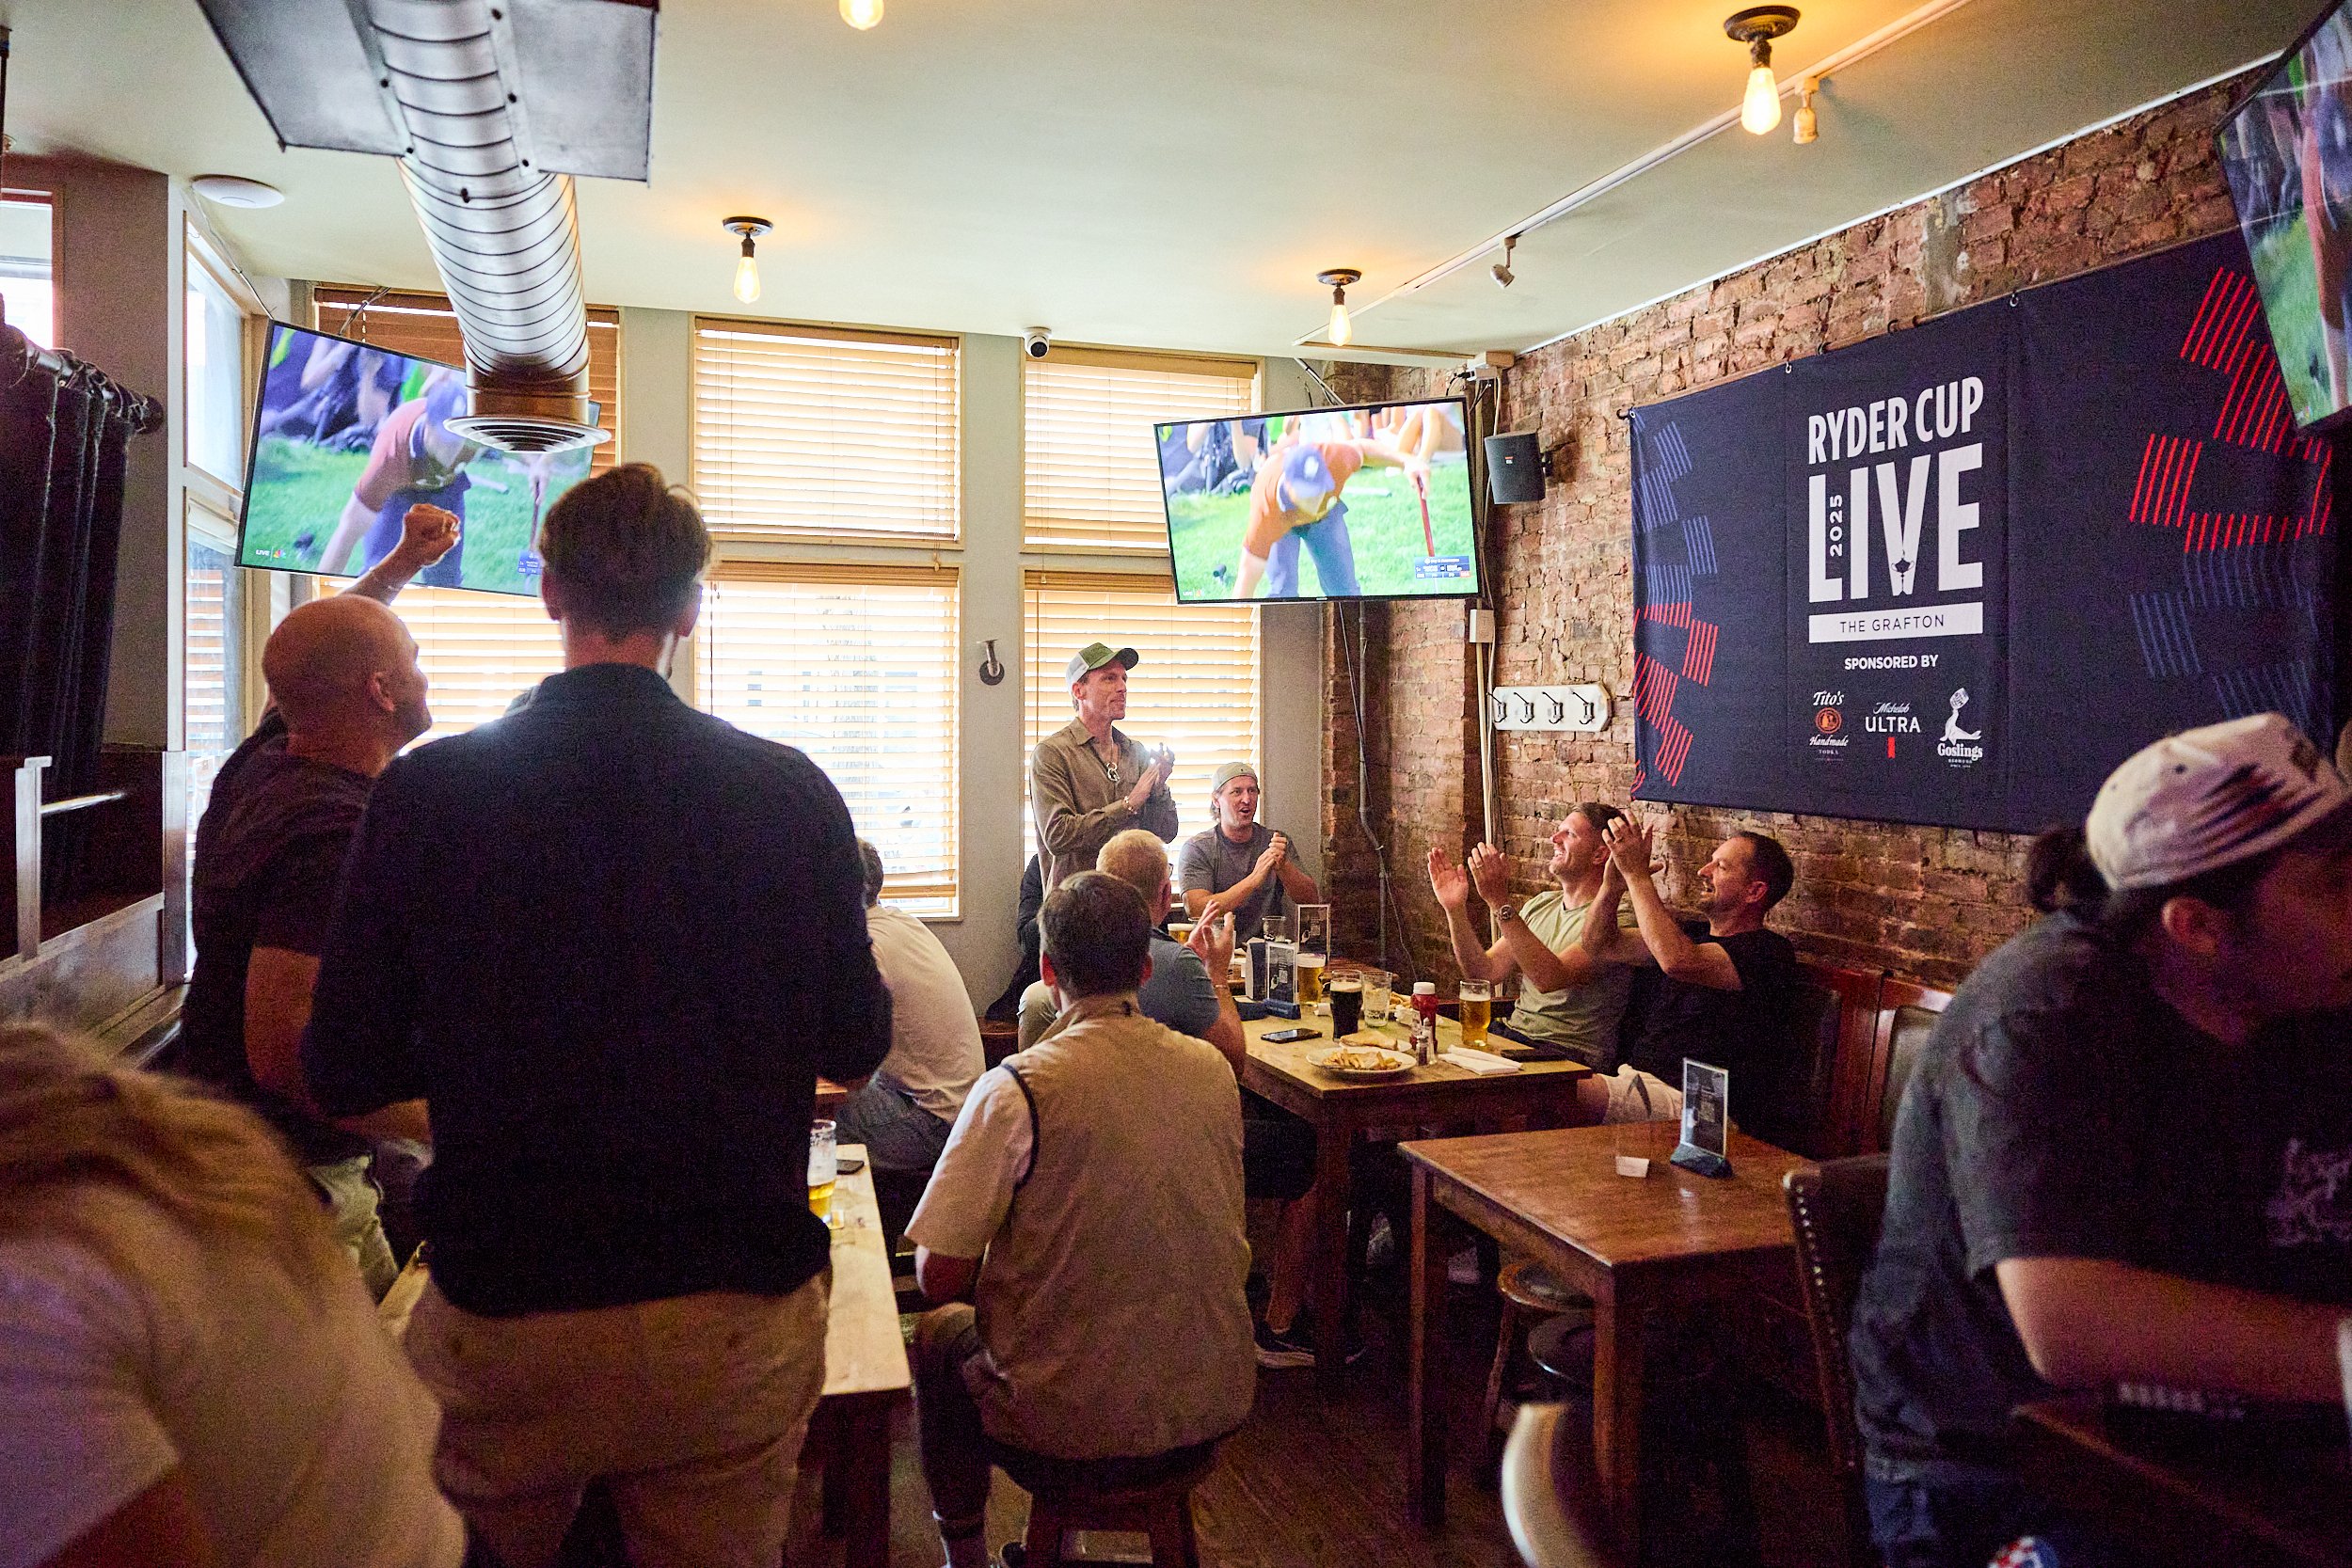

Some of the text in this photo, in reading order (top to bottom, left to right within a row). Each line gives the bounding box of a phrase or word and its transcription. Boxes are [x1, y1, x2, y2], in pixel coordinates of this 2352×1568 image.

[1808, 376, 1984, 465] RYDER CUP
[1808, 442, 1983, 603] LIVE
[1829, 494, 1843, 557] 2025
[1839, 613, 1945, 633] THE GRAFTON
[1844, 654, 1939, 670] SPONSORED BY
[1812, 689, 1845, 705] Tito's
[1865, 716, 1921, 733] ULTRA
[1809, 734, 1850, 747] Handmade
[1937, 742, 1983, 762] Goslings
